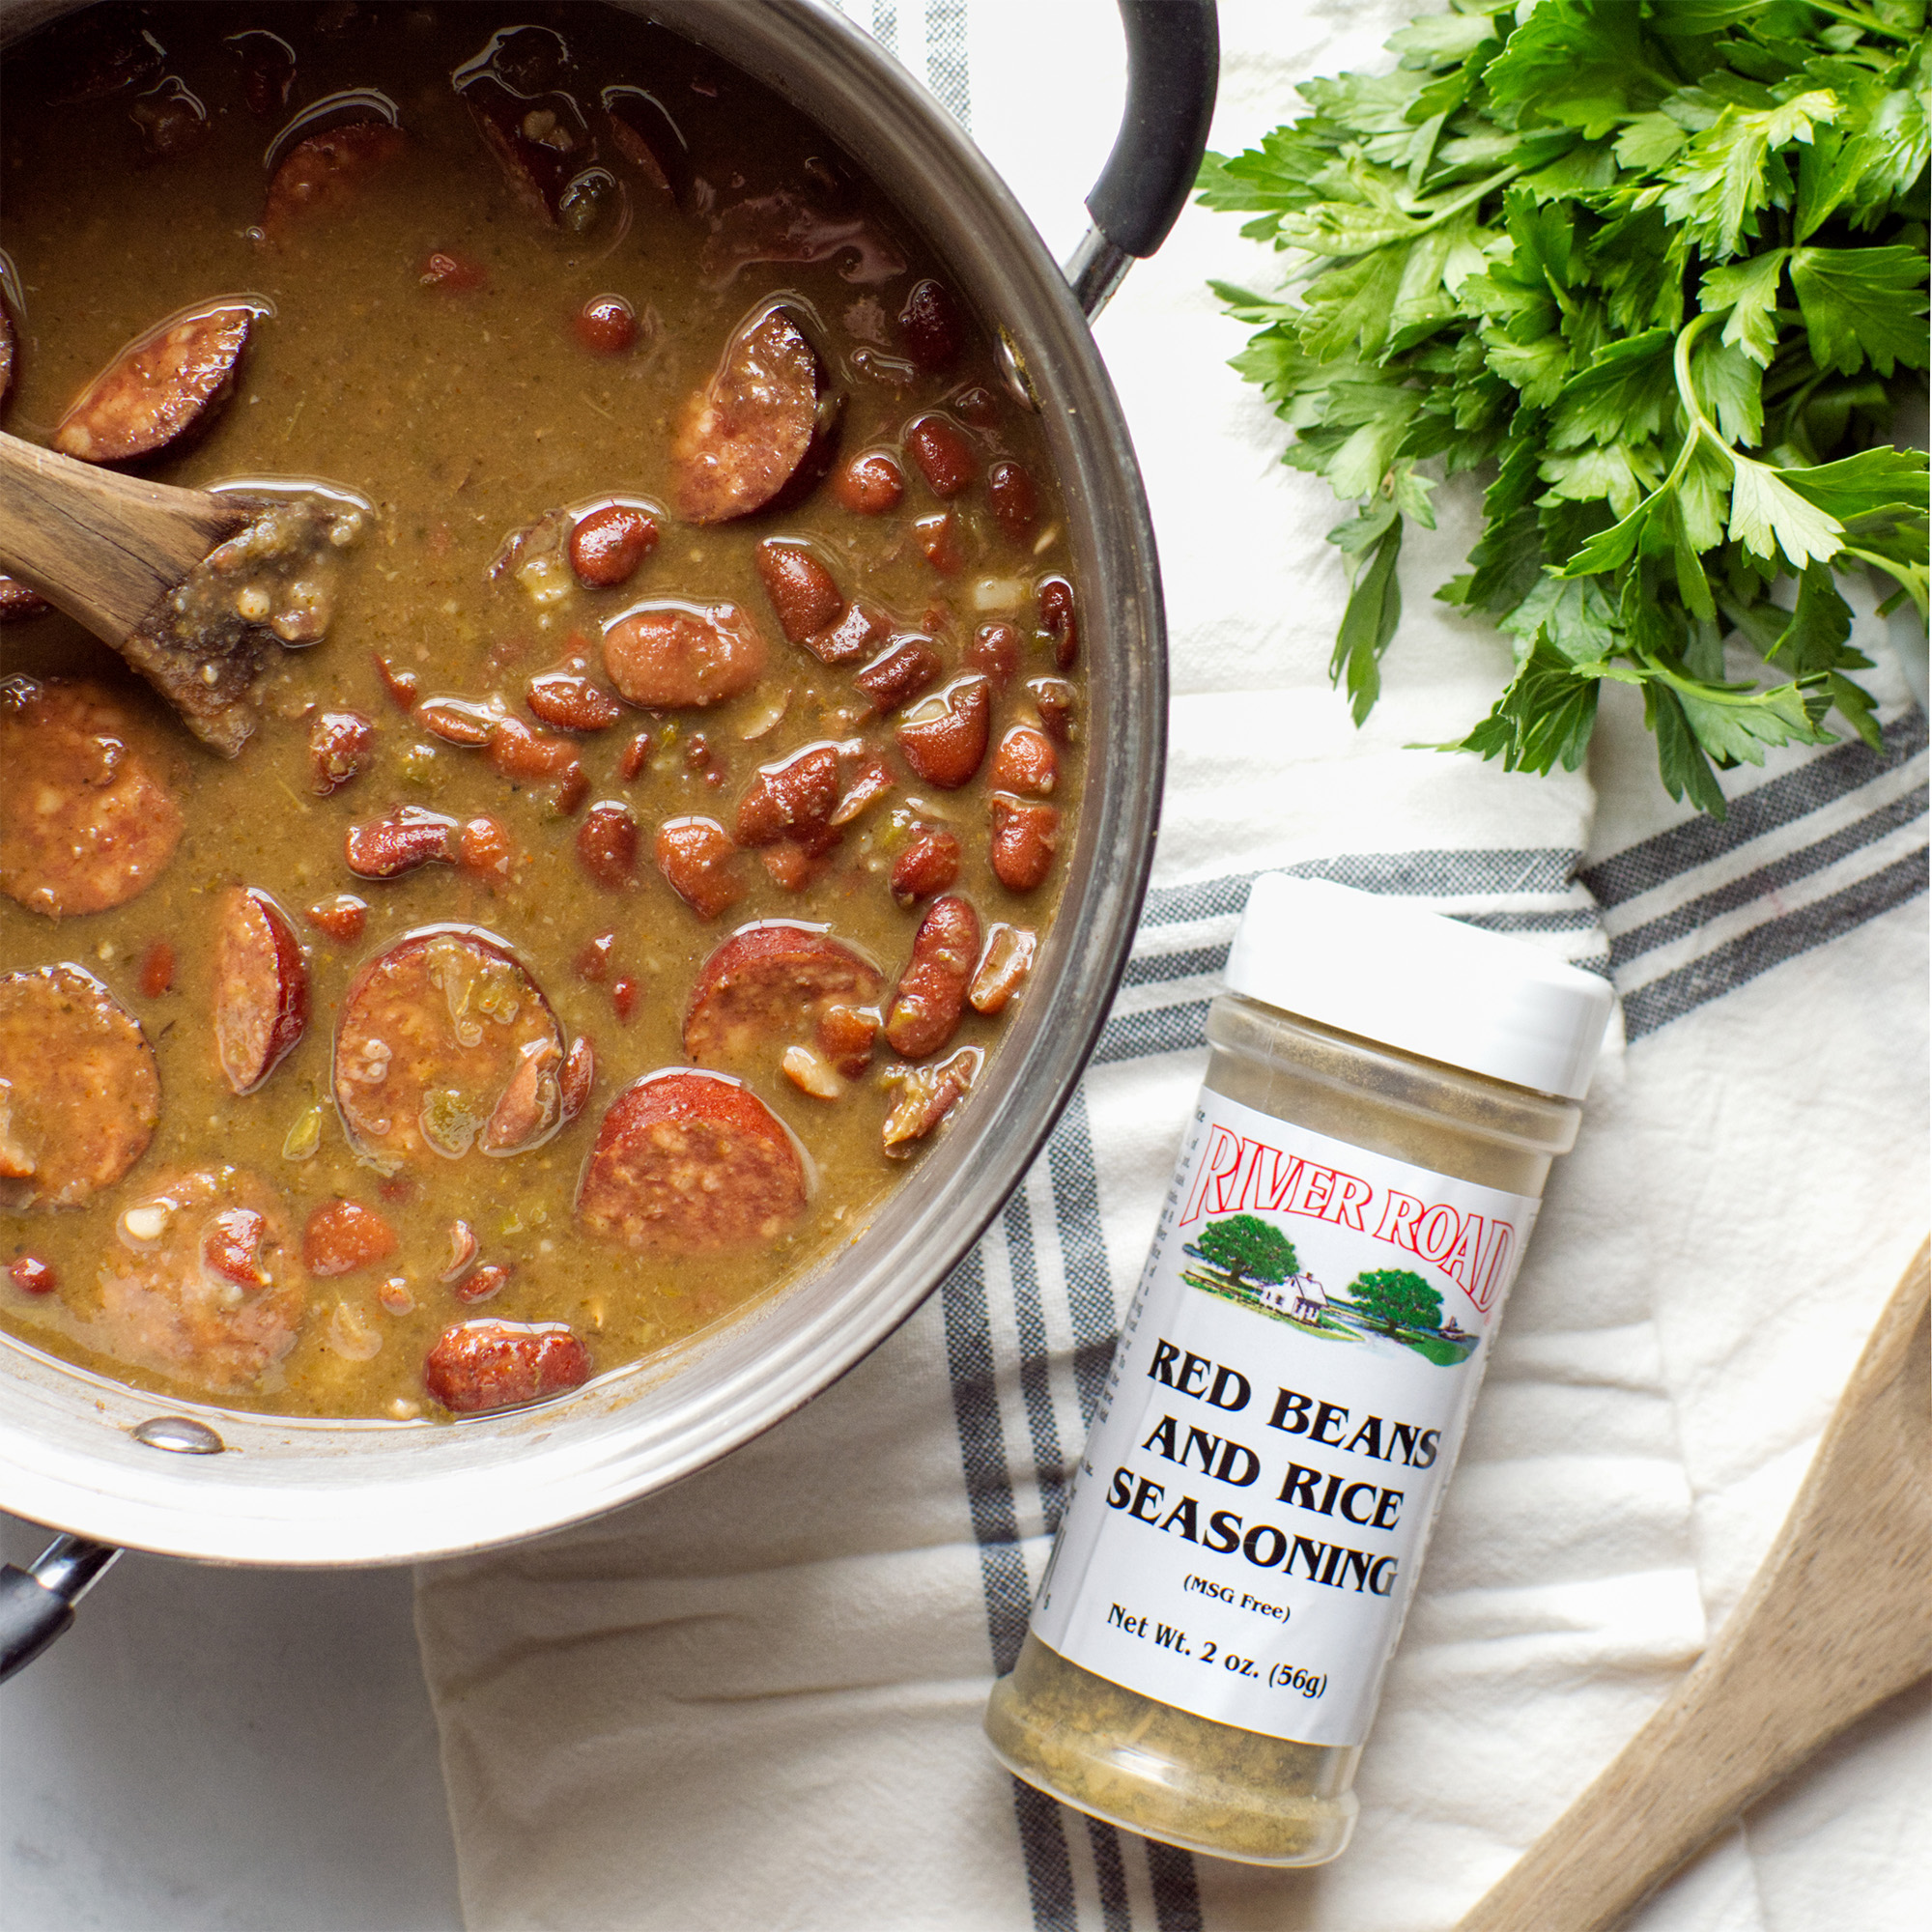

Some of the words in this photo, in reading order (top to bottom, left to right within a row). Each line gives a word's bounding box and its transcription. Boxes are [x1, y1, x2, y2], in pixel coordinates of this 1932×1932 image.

[1178, 1122, 1374, 1233] RIVER
[1372, 1188, 1517, 1315] ROAD
[1147, 1337, 1252, 1412] RED
[1266, 1387, 1442, 1470] BEANS
[1105, 1466, 1400, 1598] SEASONING
[1141, 1414, 1261, 1488] AND
[1276, 1462, 1405, 1531] RICE
[1107, 1603, 1149, 1639] Net
[1154, 1622, 1192, 1657] Wt.
[1199, 1642, 1218, 1664] 2
[1224, 1654, 1260, 1679] oz.
[1267, 1663, 1328, 1699] (56g)
[1182, 1574, 1236, 1605] (MSG
[1240, 1594, 1292, 1624] Free)
